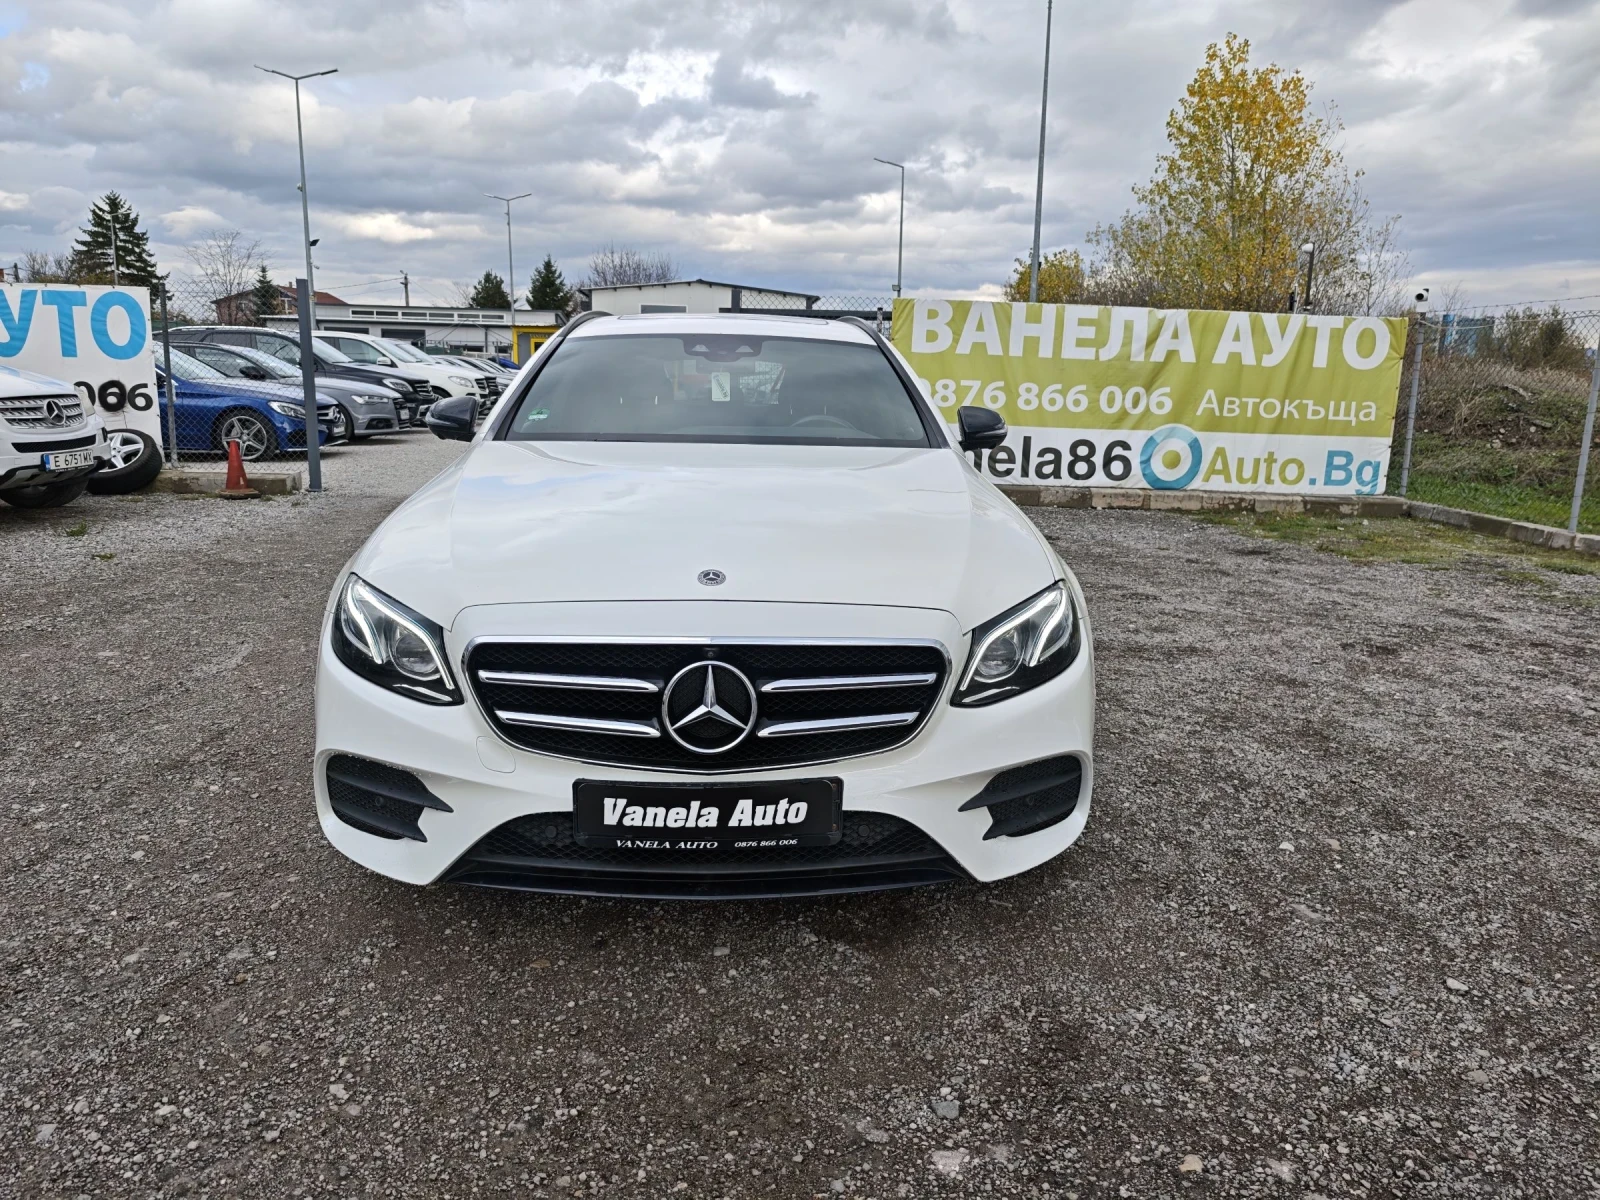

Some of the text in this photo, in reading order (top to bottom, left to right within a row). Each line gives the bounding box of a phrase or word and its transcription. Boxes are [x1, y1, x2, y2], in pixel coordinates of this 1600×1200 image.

[911, 299, 1391, 371] ВАНЕЛА АУТО
[1017, 382, 1089, 413] 866
[1099, 385, 1173, 415] 006
[1196, 389, 1377, 426] Автокъща
[1202, 446, 1381, 495] Auto.Bg
[603, 797, 808, 828] Vanela Auto
[616, 840, 671, 849] VANELA
[675, 841, 718, 849] AUTO
[734, 840, 757, 848] 0876
